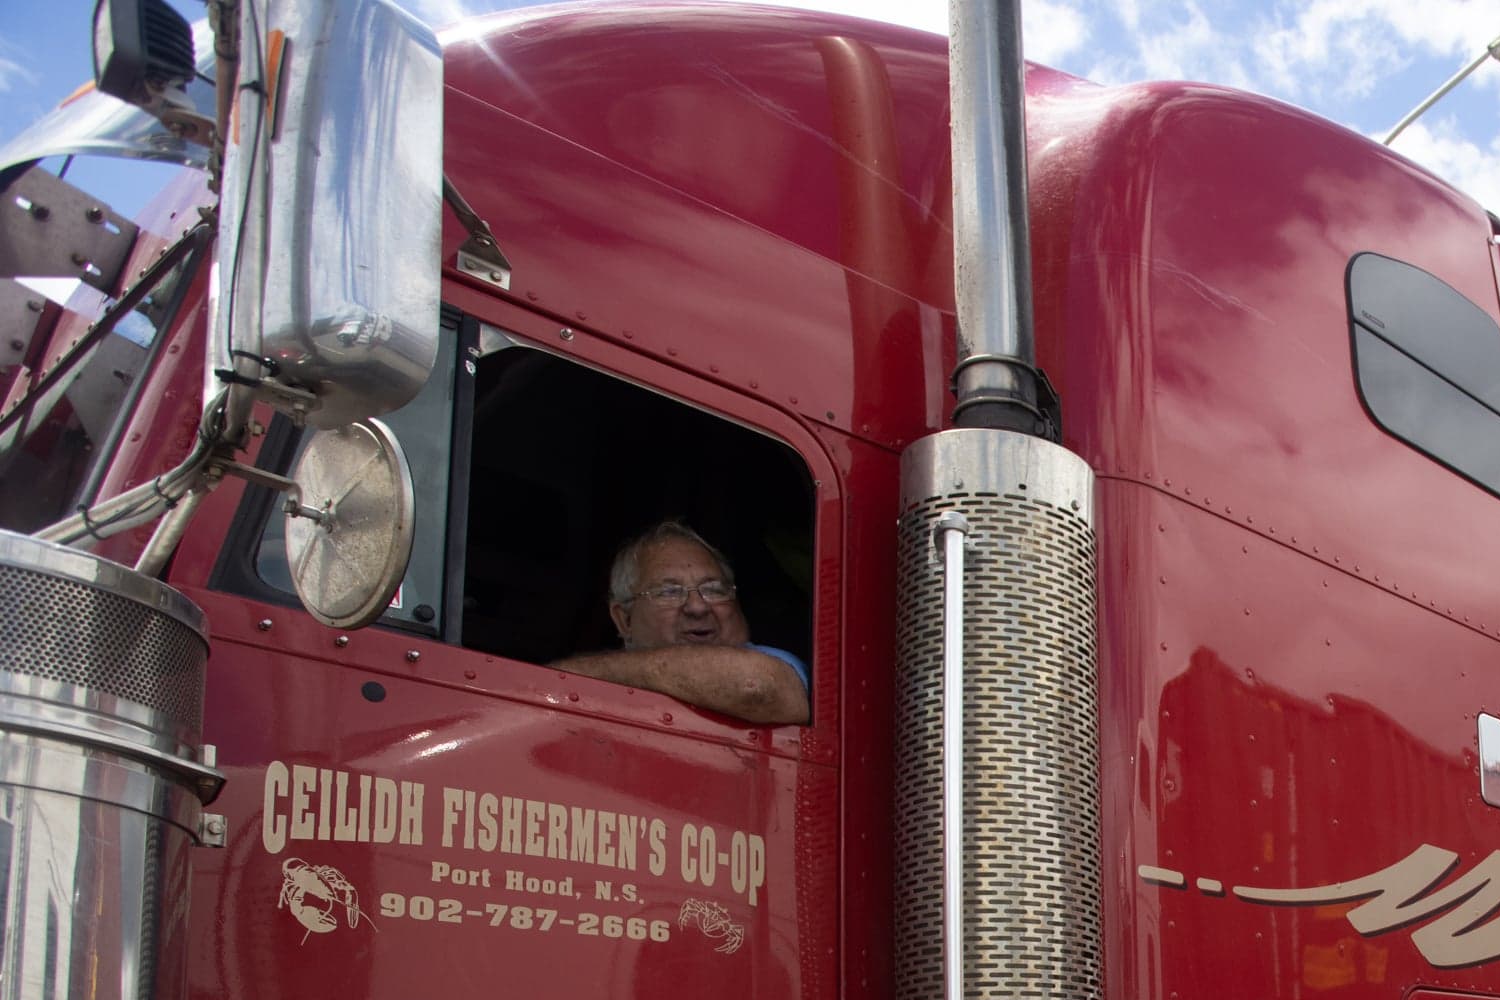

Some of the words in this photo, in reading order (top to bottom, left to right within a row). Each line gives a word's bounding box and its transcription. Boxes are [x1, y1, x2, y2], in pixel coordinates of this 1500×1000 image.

[262, 760, 424, 854] CEILIDH
[441, 787, 667, 877] FISHERMEN'S
[680, 823, 766, 907] CO-OP
[431, 861, 491, 889] Port
[505, 870, 582, 900] Hood,
[595, 881, 645, 905] N.S.
[379, 892, 671, 943] 902-787-2666
